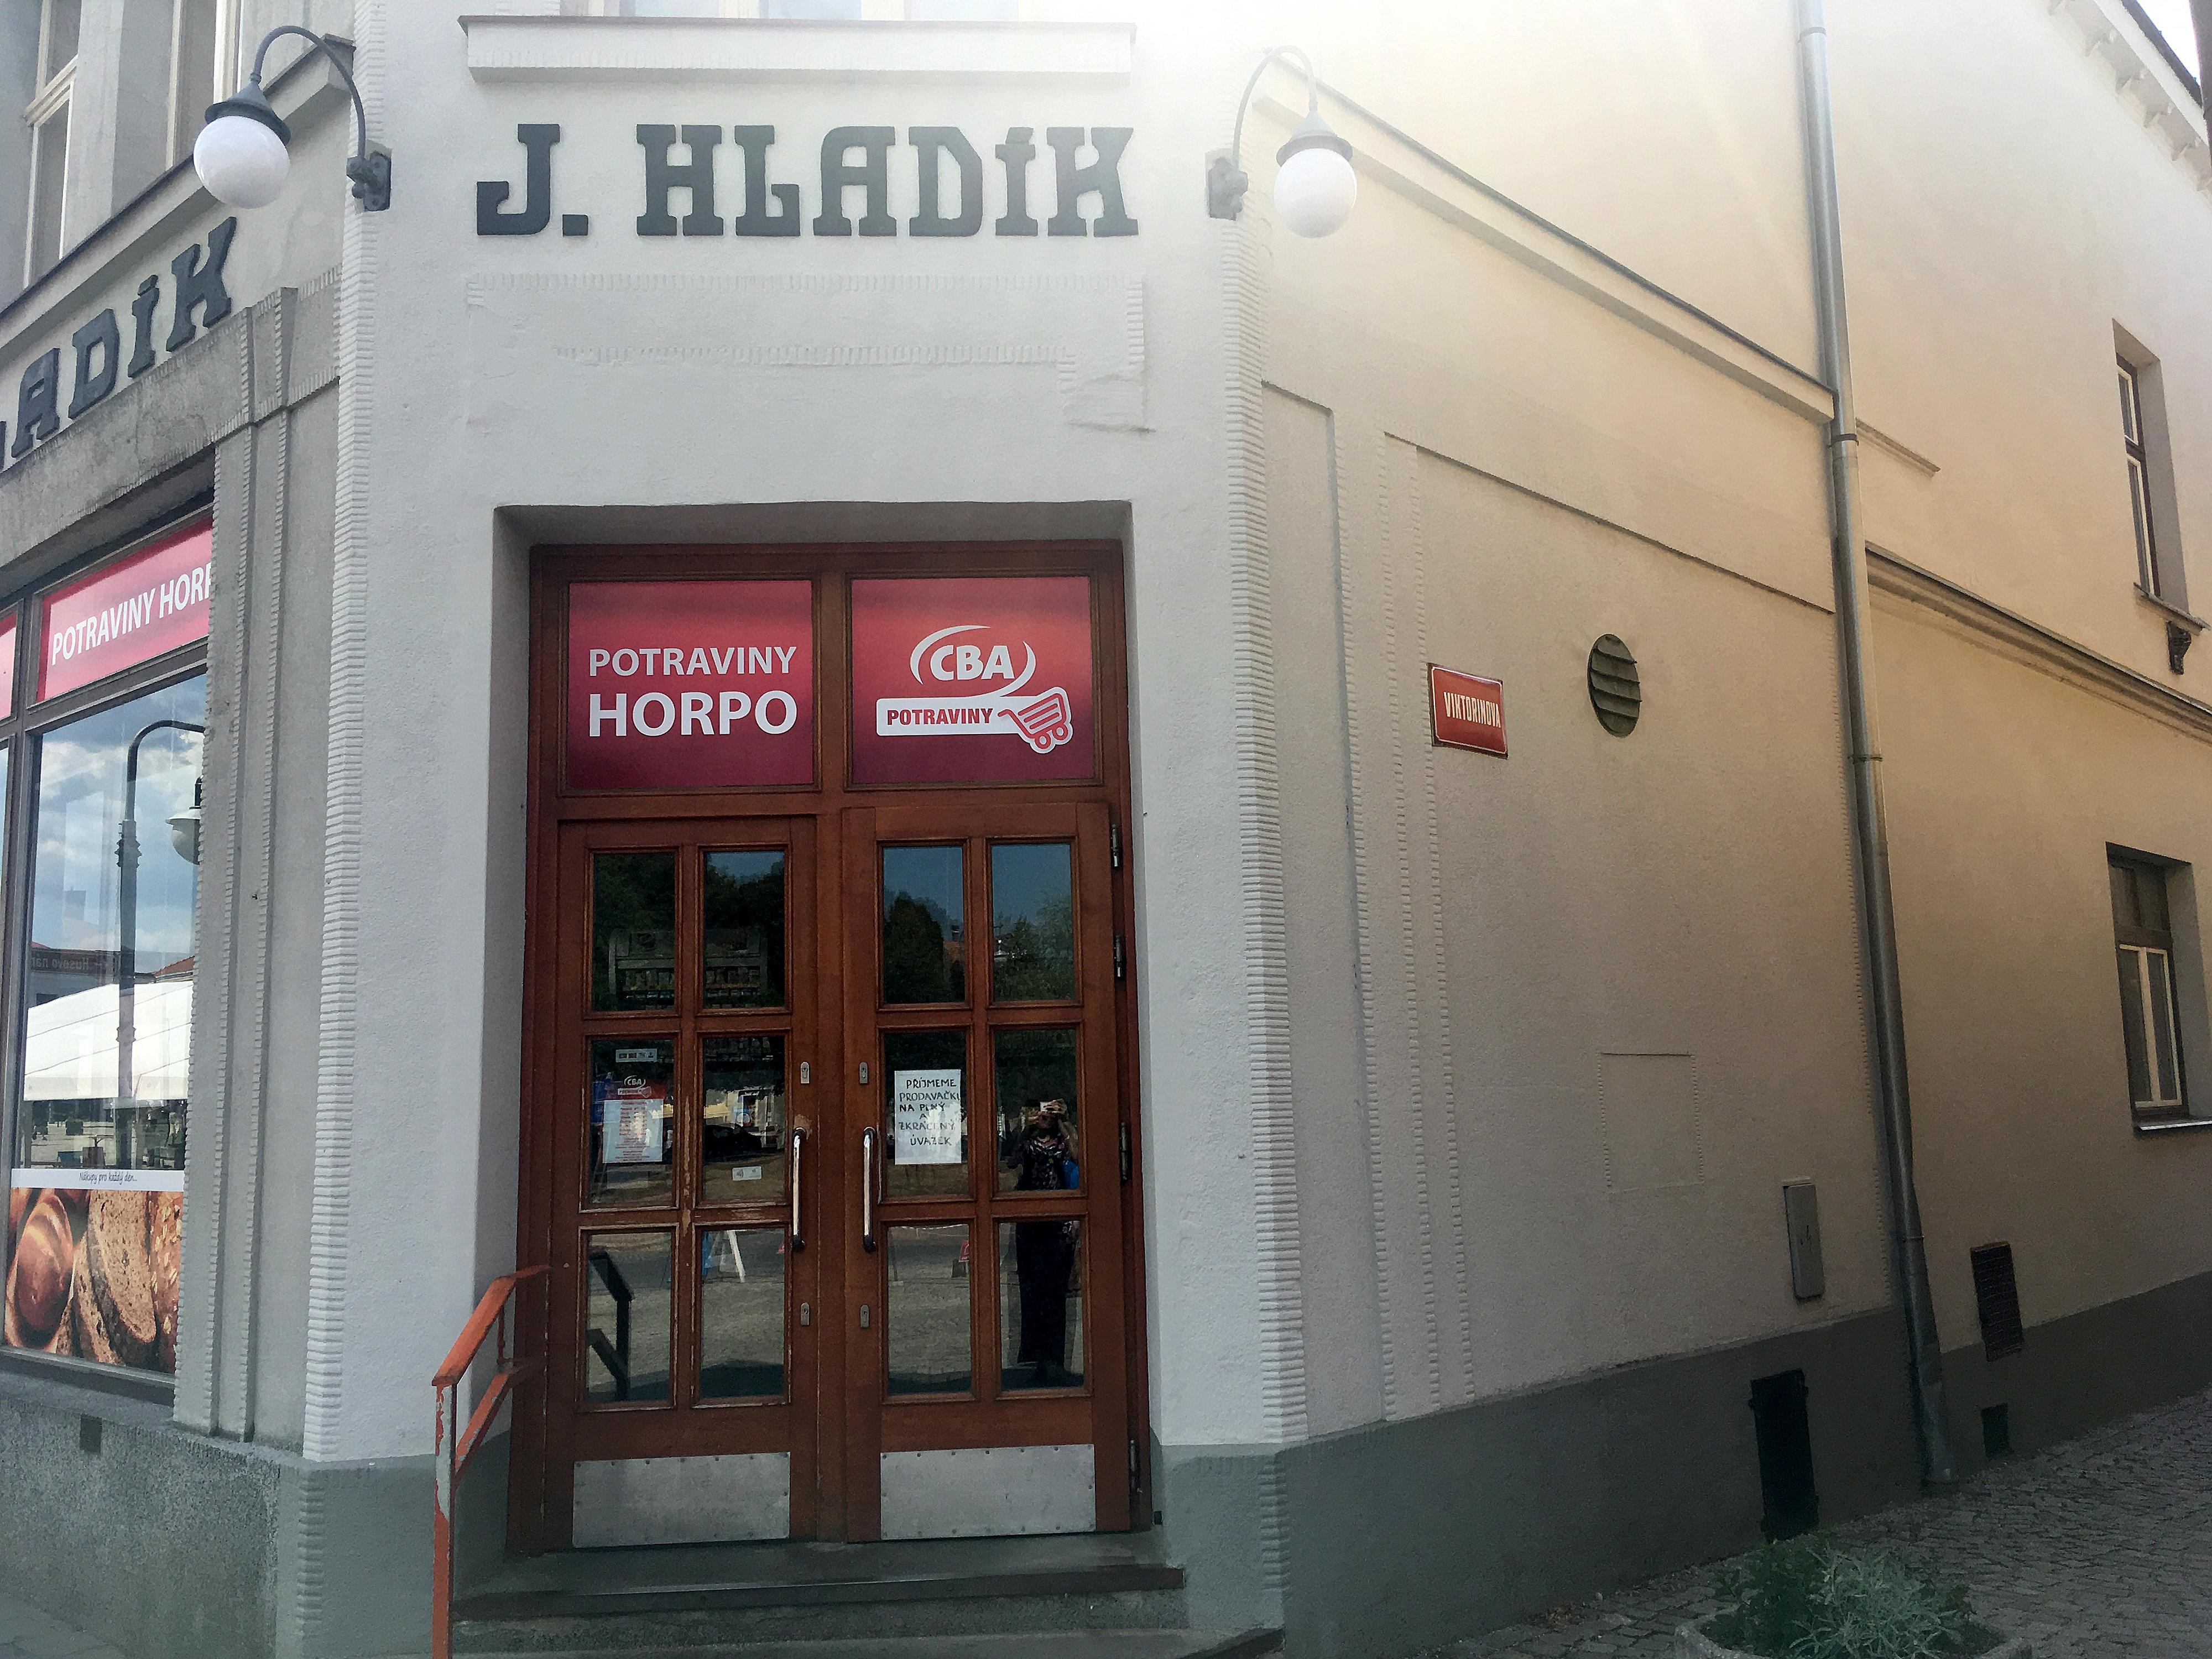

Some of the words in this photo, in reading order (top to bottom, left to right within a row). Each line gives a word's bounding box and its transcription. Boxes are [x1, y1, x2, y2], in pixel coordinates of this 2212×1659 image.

[476, 123, 589, 237] J.
[636, 123, 1139, 237] HLADÍK
[0, 217, 237, 470] ADÍK
[51, 588, 156, 666] POTRAVINY
[589, 646, 797, 676] POTRAVINY
[930, 645, 1015, 681] CBA
[589, 690, 797, 737] HORPO
[887, 708, 993, 726] POTRAVINY
[1443, 691, 1501, 728] VIKTORINOVA
[899, 1103, 915, 1113] NA
[98, 1173, 107, 1185] pro
